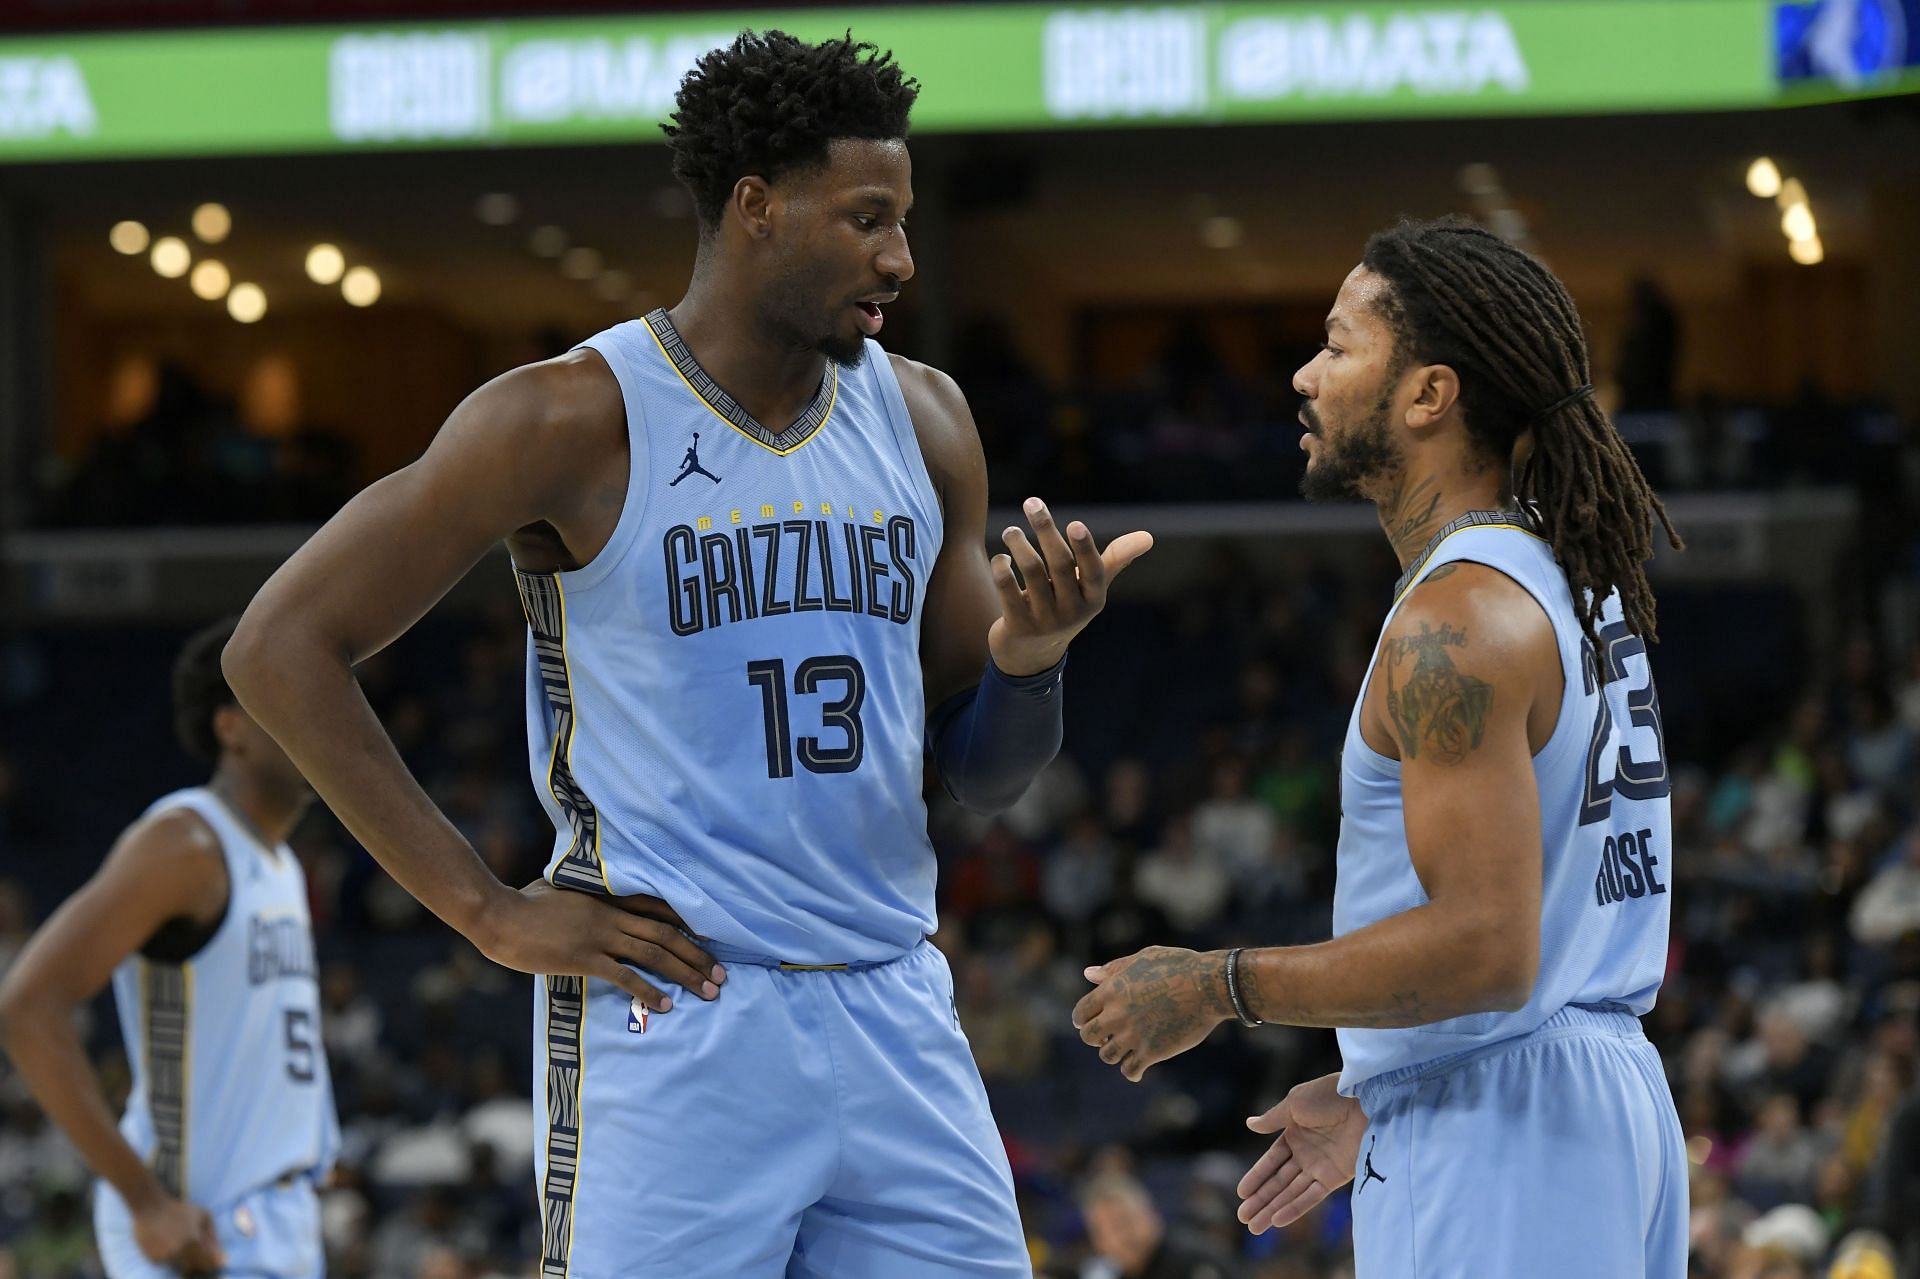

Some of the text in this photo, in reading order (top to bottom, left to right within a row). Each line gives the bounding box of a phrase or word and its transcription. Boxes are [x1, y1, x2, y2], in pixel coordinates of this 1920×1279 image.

[663, 515, 915, 636] GRIZZLIES
[697, 501, 883, 530] MEMPHIS
[747, 654, 866, 779] 13
[1579, 620, 1671, 827] 23
[282, 1007, 318, 1083] 5
